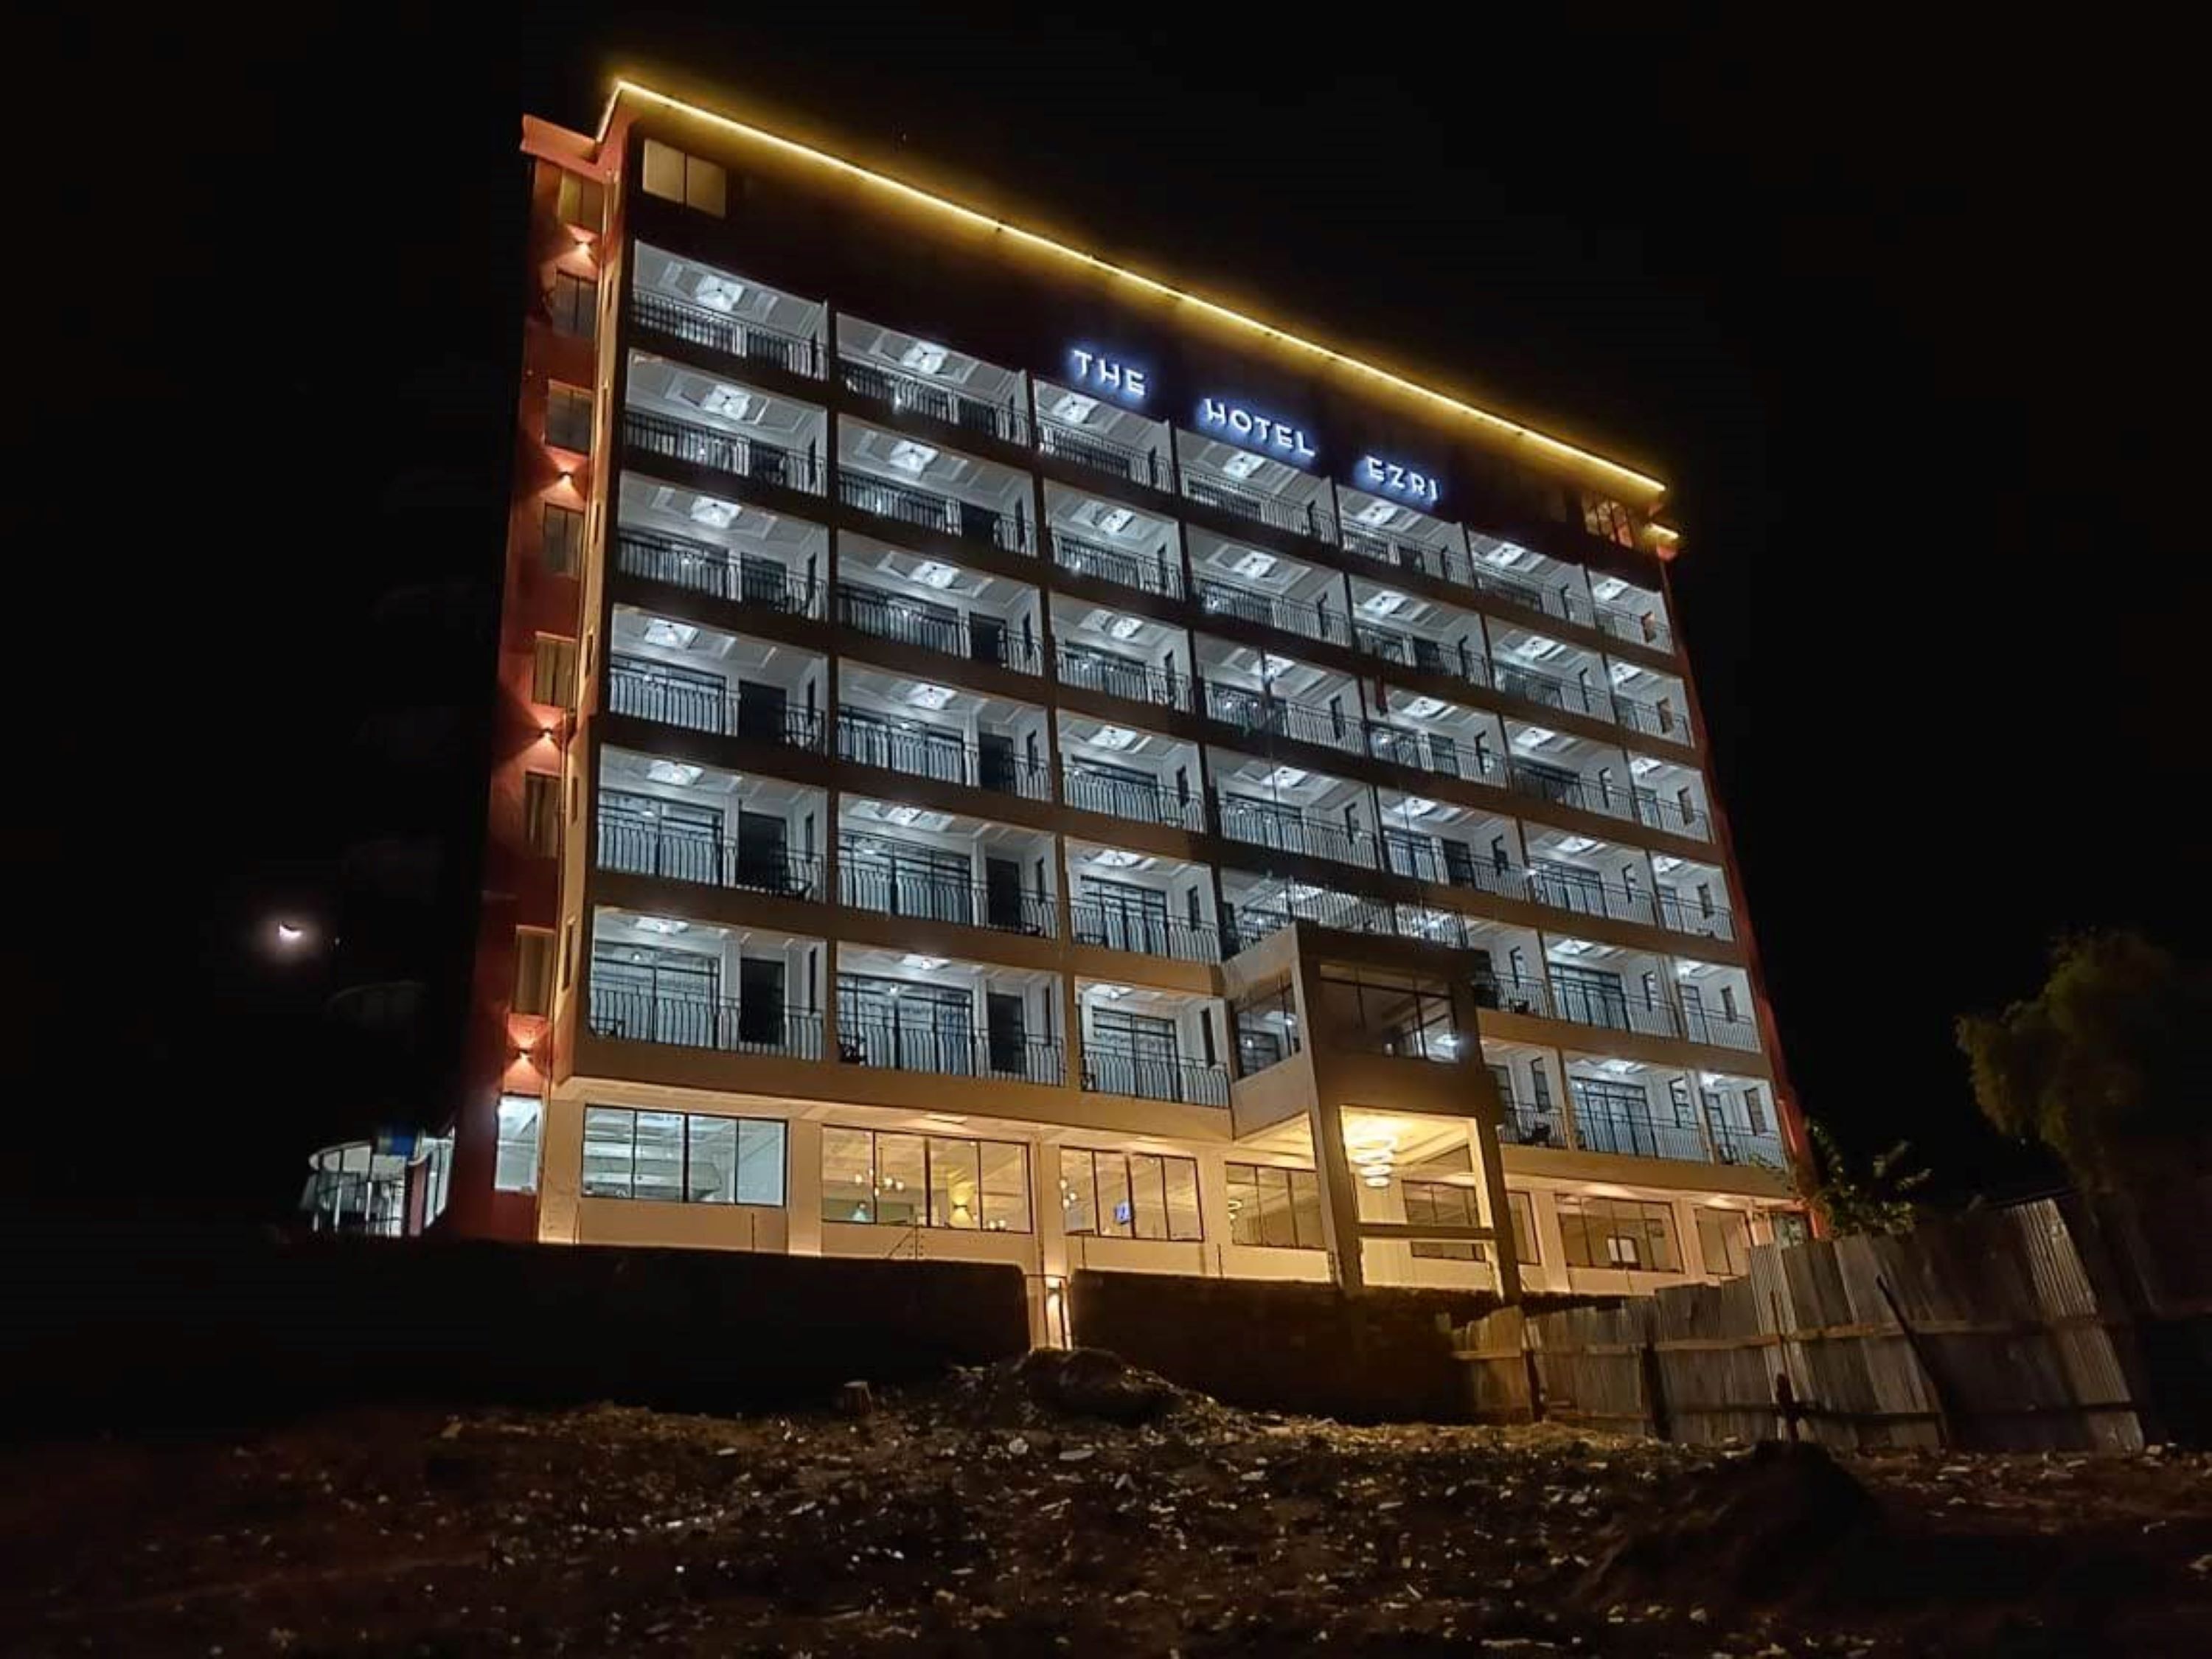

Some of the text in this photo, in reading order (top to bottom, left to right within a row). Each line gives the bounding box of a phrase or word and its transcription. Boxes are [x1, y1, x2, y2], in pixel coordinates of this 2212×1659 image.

[1073, 349, 1439, 502] THE HOTEL EZRI
